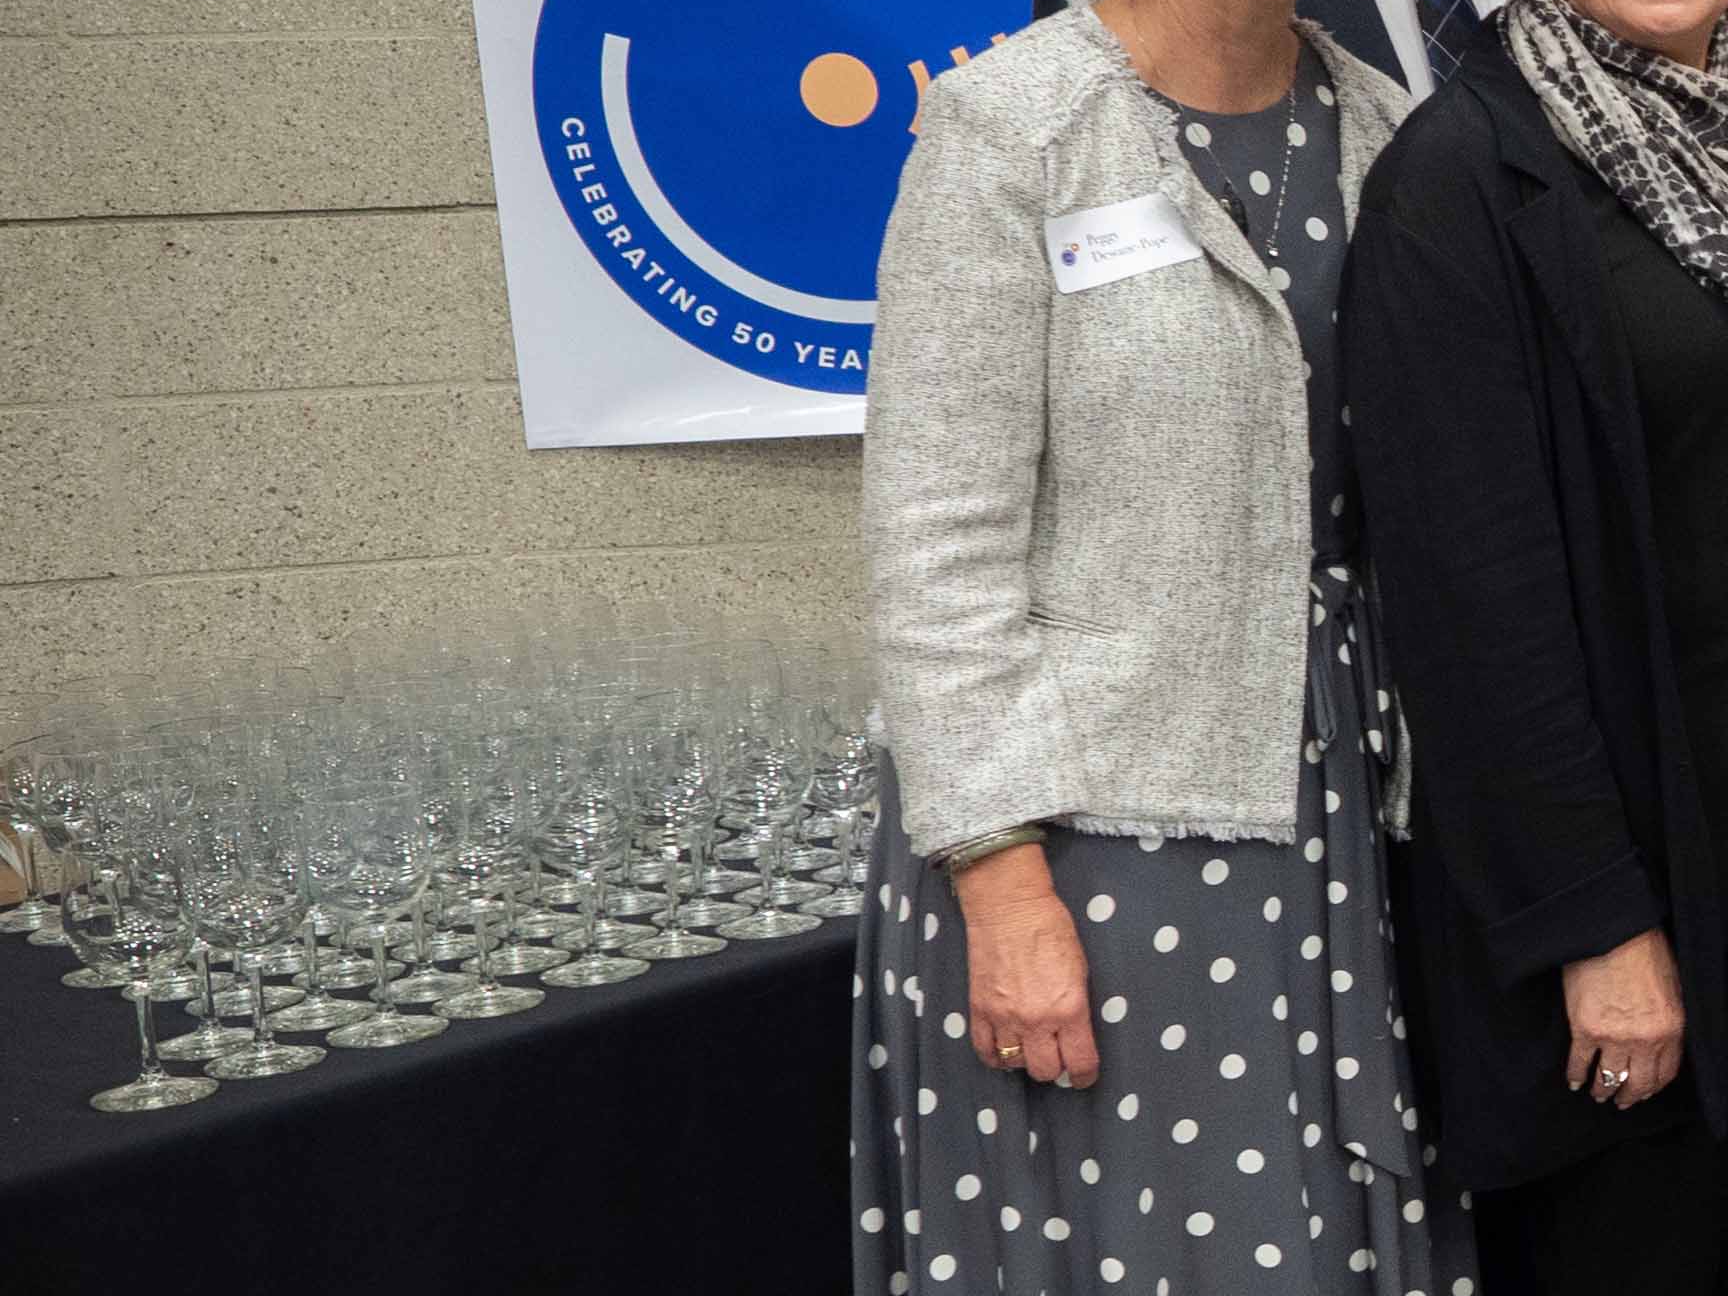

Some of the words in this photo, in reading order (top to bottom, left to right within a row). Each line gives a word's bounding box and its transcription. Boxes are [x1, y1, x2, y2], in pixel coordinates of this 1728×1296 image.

[560, 116, 719, 327] CELEBRATING
[731, 321, 776, 354] 50
[793, 341, 878, 370] YEA
